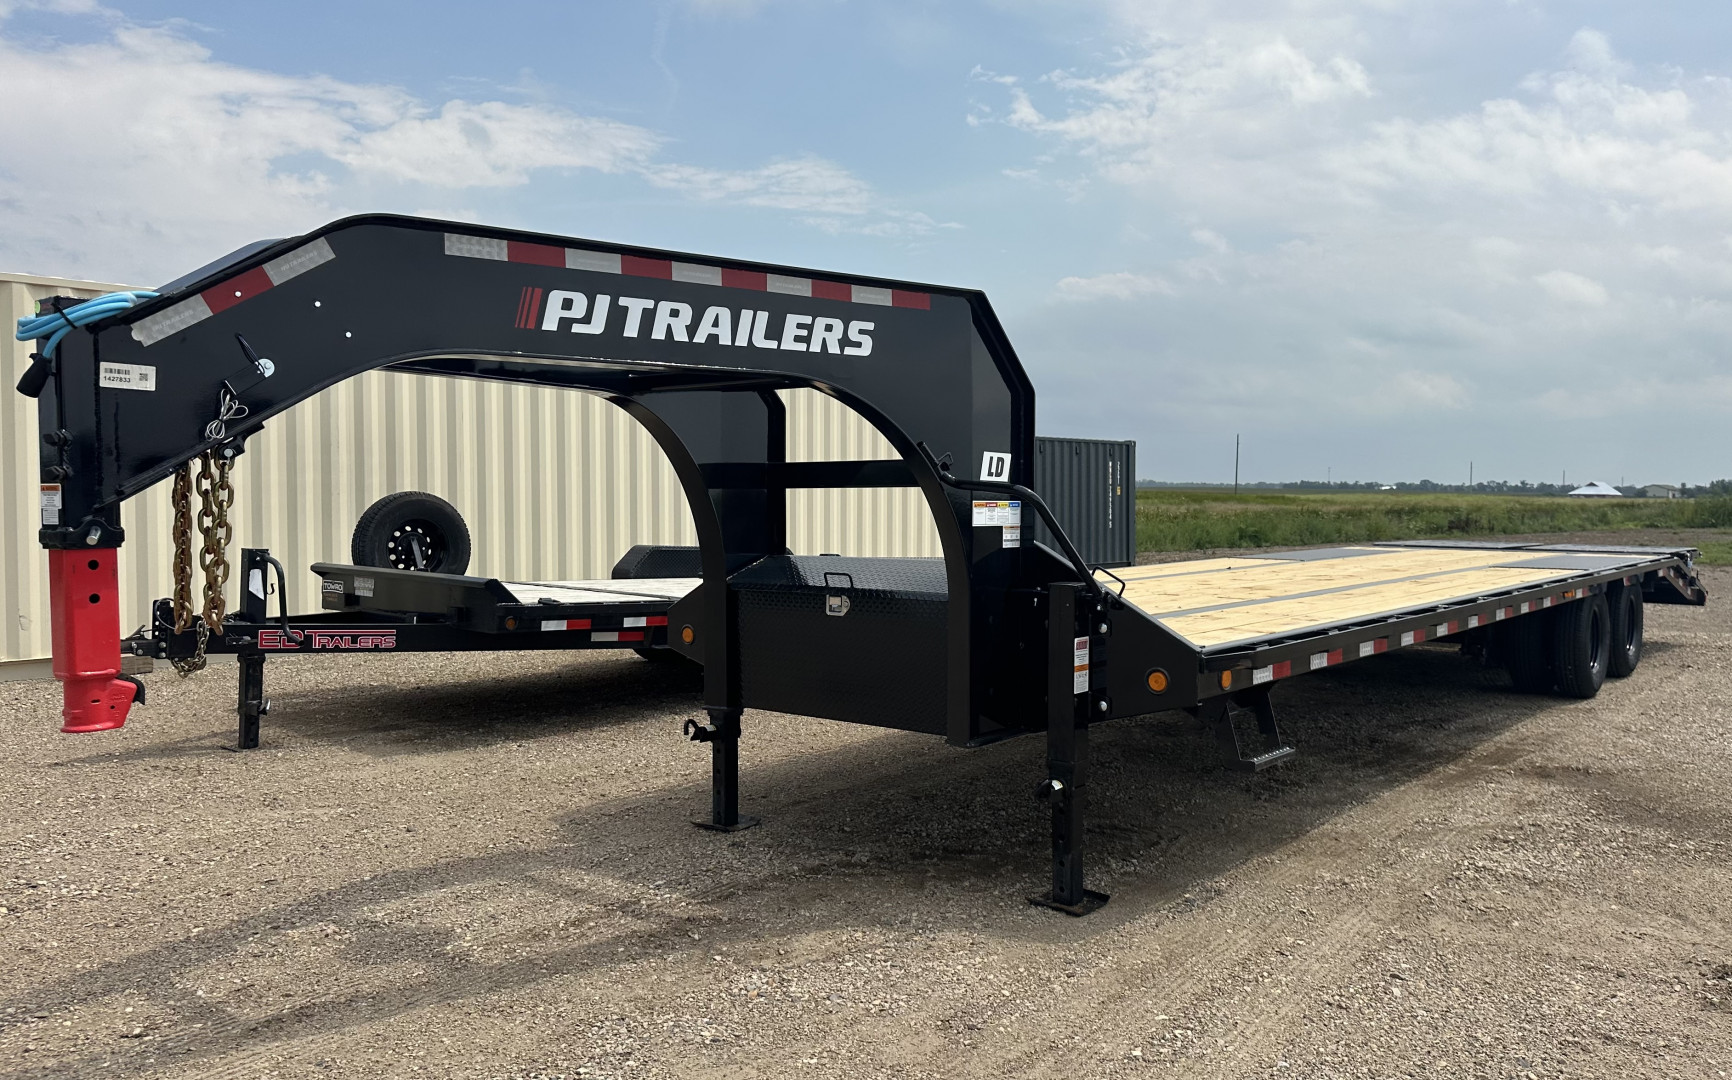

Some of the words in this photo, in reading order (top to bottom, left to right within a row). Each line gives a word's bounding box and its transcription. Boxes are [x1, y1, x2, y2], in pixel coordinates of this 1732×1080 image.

[542, 289, 611, 335] PJ
[618, 296, 875, 357] TRAILERS
[103, 375, 131, 383] 1427833
[987, 456, 1005, 477] LD
[305, 629, 397, 649] TRAILERS
